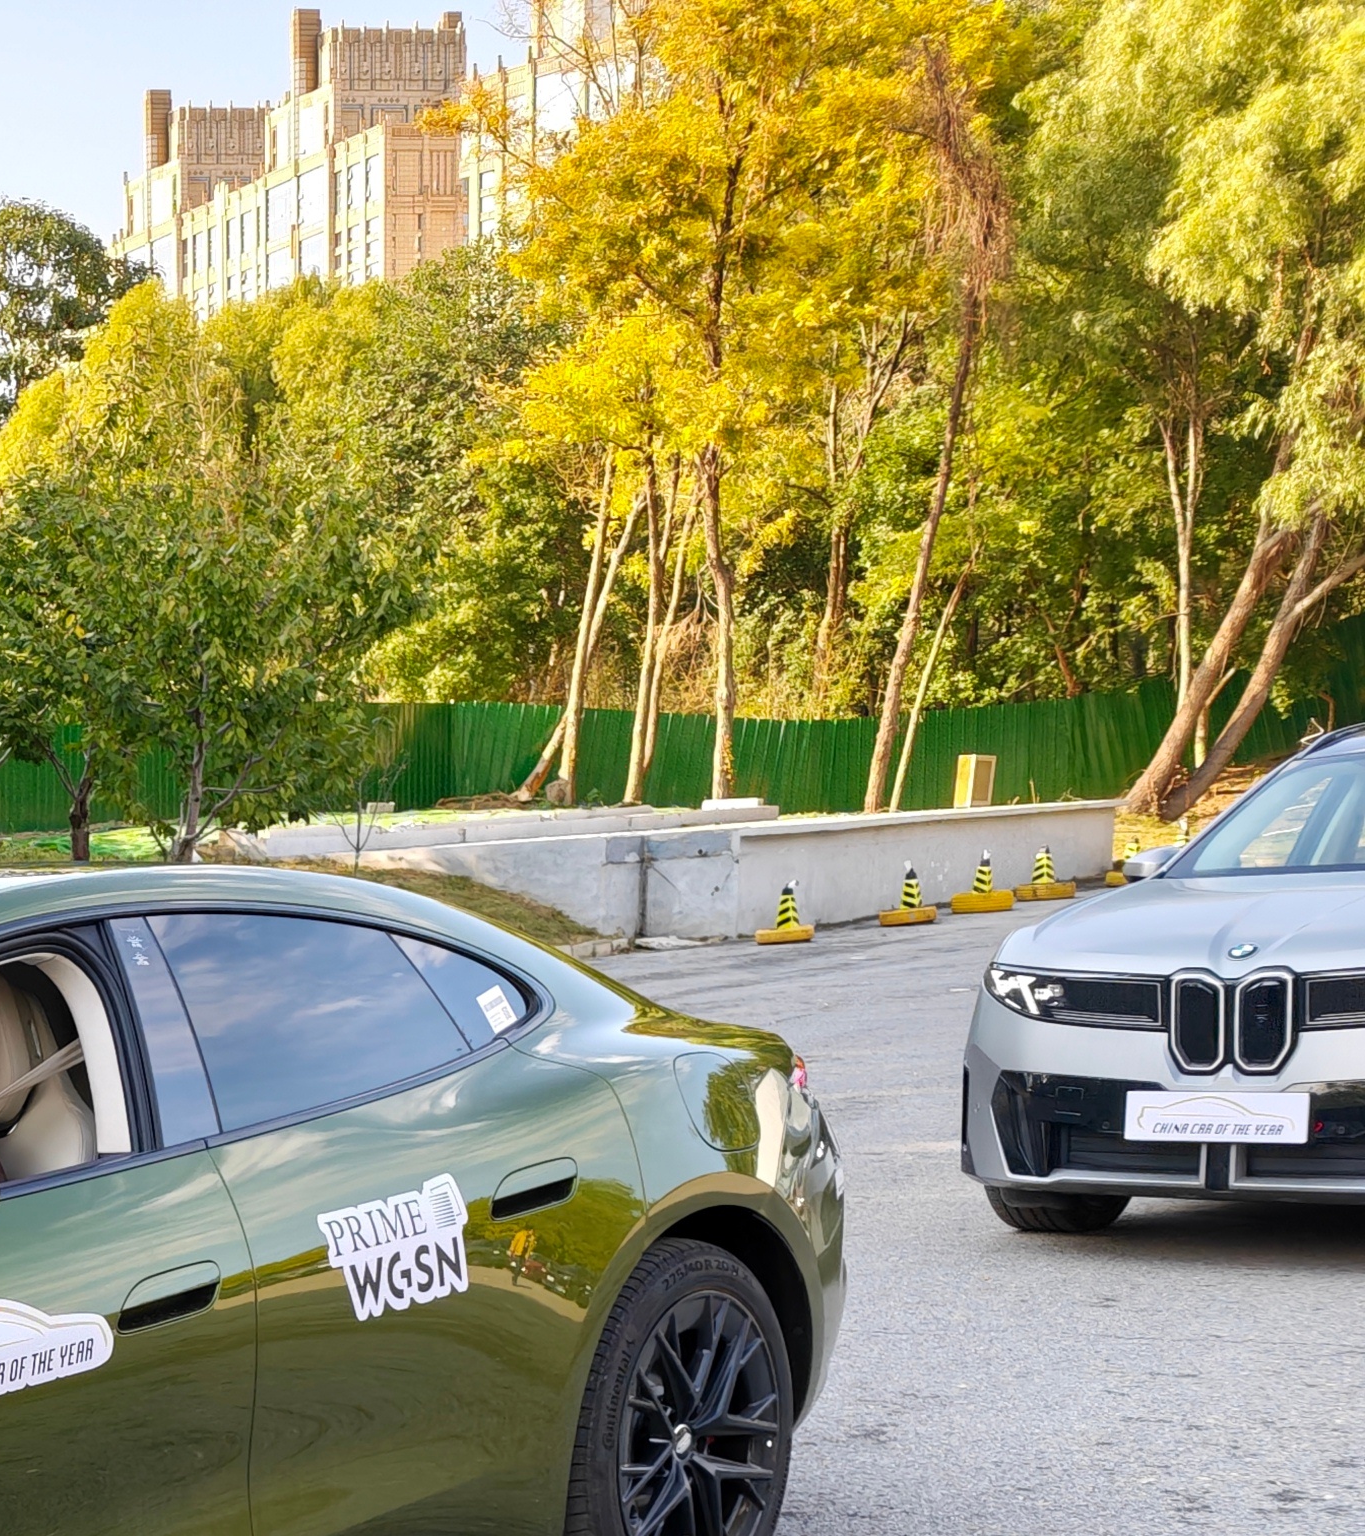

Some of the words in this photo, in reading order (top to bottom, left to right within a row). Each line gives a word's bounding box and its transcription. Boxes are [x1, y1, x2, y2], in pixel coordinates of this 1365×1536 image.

[1152, 1122, 1189, 1134] CHINA
[1190, 1123, 1214, 1134] CAR
[1214, 1123, 1230, 1135] OF
[1231, 1124, 1252, 1135] THE
[1253, 1124, 1284, 1135] YEAR
[324, 1199, 427, 1257] PRIME
[349, 1236, 463, 1310] WGSN
[9, 1356, 28, 1382] OF
[31, 1348, 56, 1376] THE
[60, 1338, 94, 1368] YEAR
